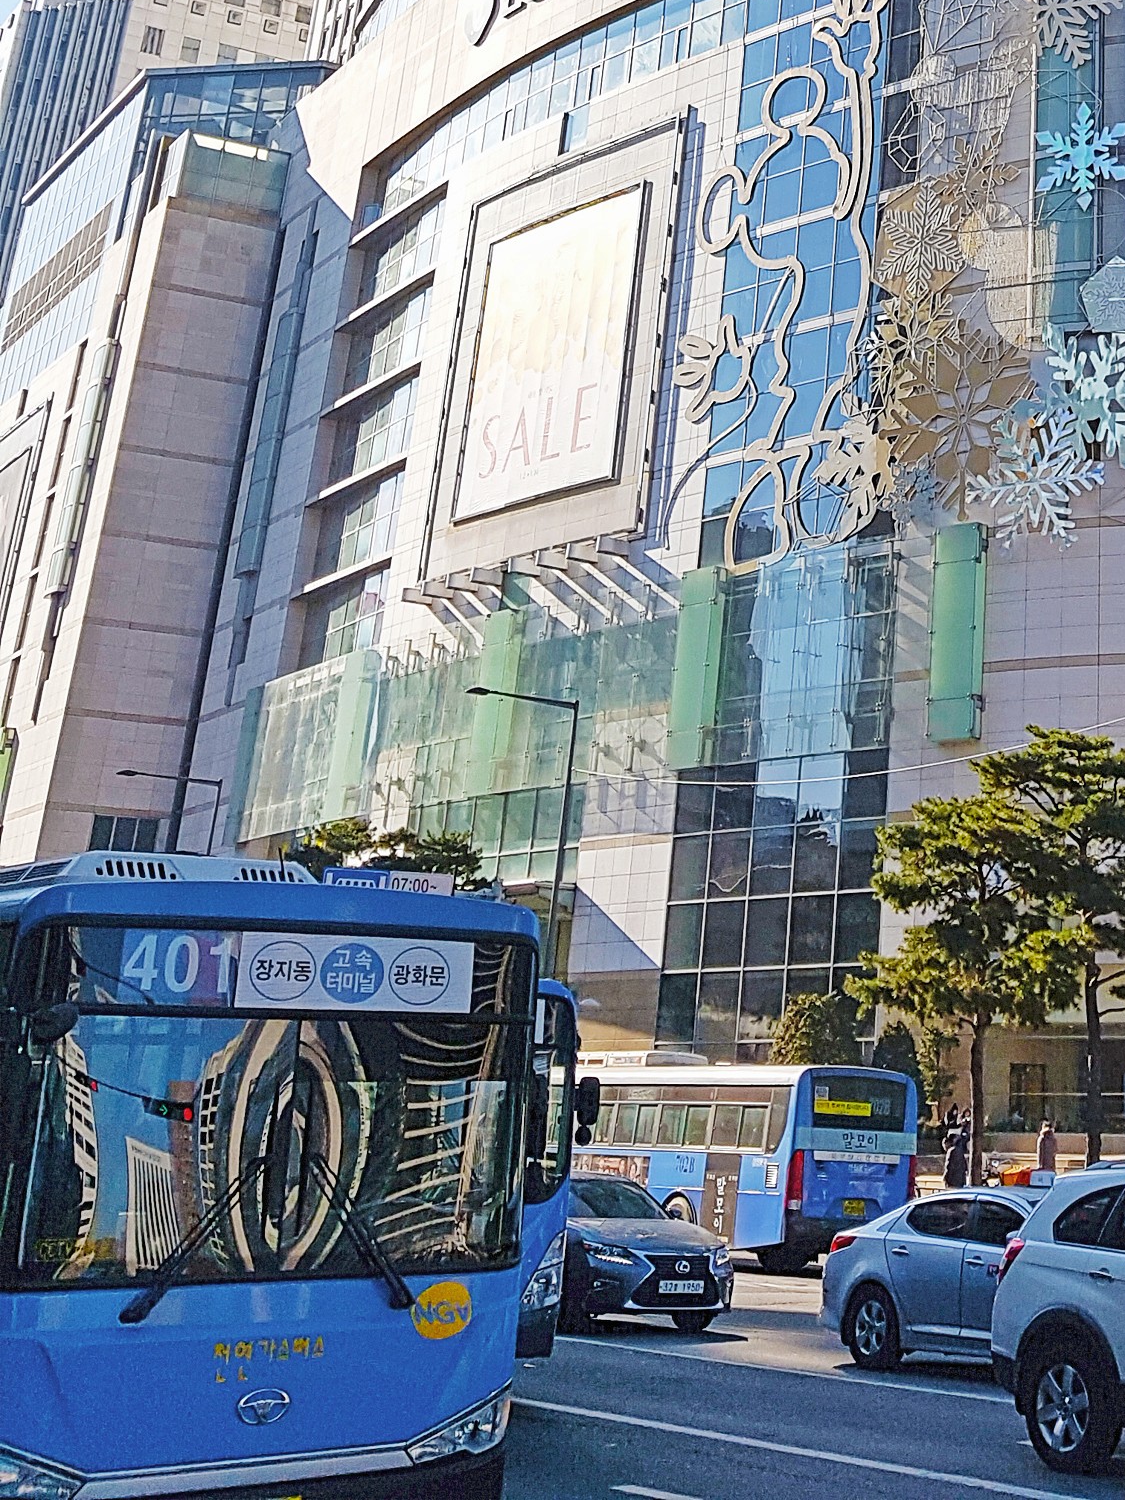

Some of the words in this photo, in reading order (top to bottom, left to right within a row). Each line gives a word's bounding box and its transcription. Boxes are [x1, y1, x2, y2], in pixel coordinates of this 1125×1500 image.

[478, 383, 599, 480] SALE
[123, 934, 231, 994] 401
[254, 958, 313, 983] 장지동
[332, 949, 373, 971] 고속
[325, 971, 377, 995] 터미널
[392, 964, 447, 988] 광화문
[842, 1131, 879, 1151] 말모이
[712, 1175, 727, 1234] 말모이
[414, 1300, 470, 1324] NGV
